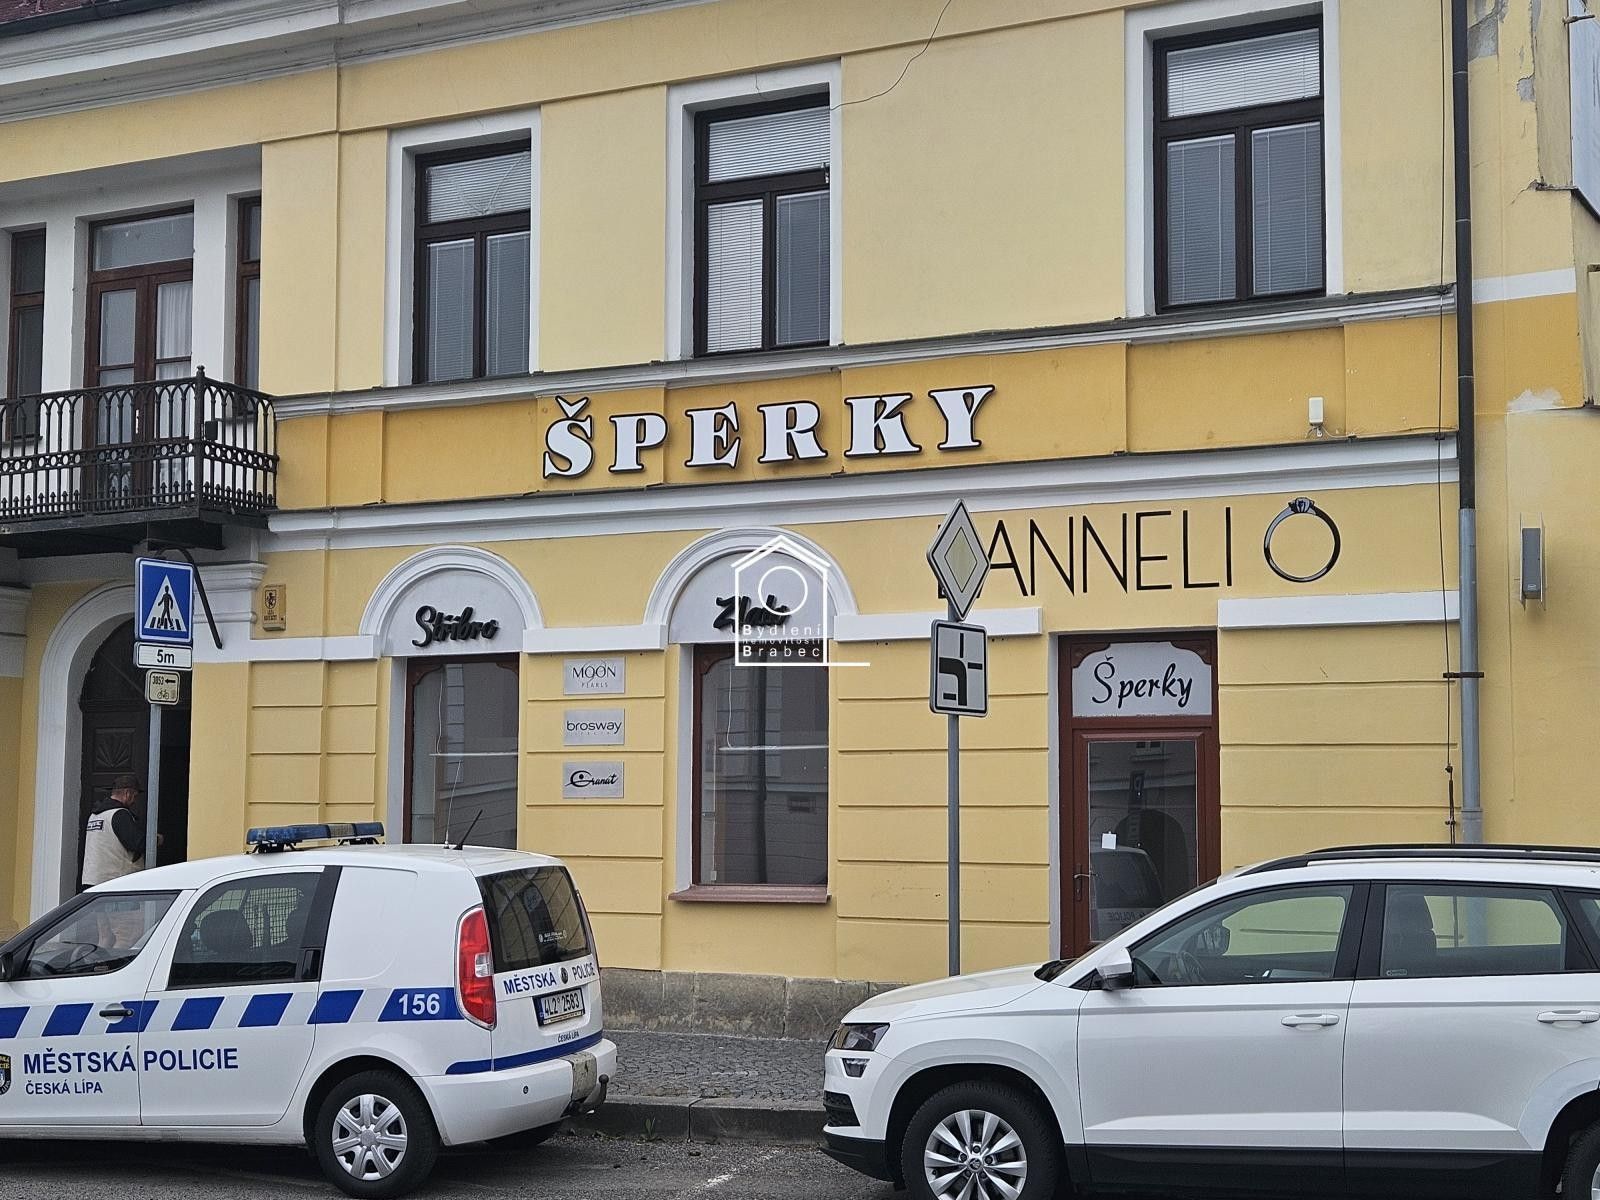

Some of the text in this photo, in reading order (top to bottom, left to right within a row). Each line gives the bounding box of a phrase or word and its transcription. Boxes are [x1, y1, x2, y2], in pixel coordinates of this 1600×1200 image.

[542, 384, 996, 480] ŠPERKY
[938, 506, 1232, 599] ANNELI
[156, 649, 175, 665] 5m
[1091, 654, 1193, 709] Šperky
[566, 720, 622, 734] brosway
[503, 962, 596, 995] MĚSTSKÁ POLICIE
[398, 993, 440, 1015] 156
[23, 1045, 136, 1074] MĚSTSKÁ
[143, 1048, 239, 1071] POLICIE
[25, 1079, 70, 1095] ČESKÁ
[74, 1078, 103, 1094] LÍPA
